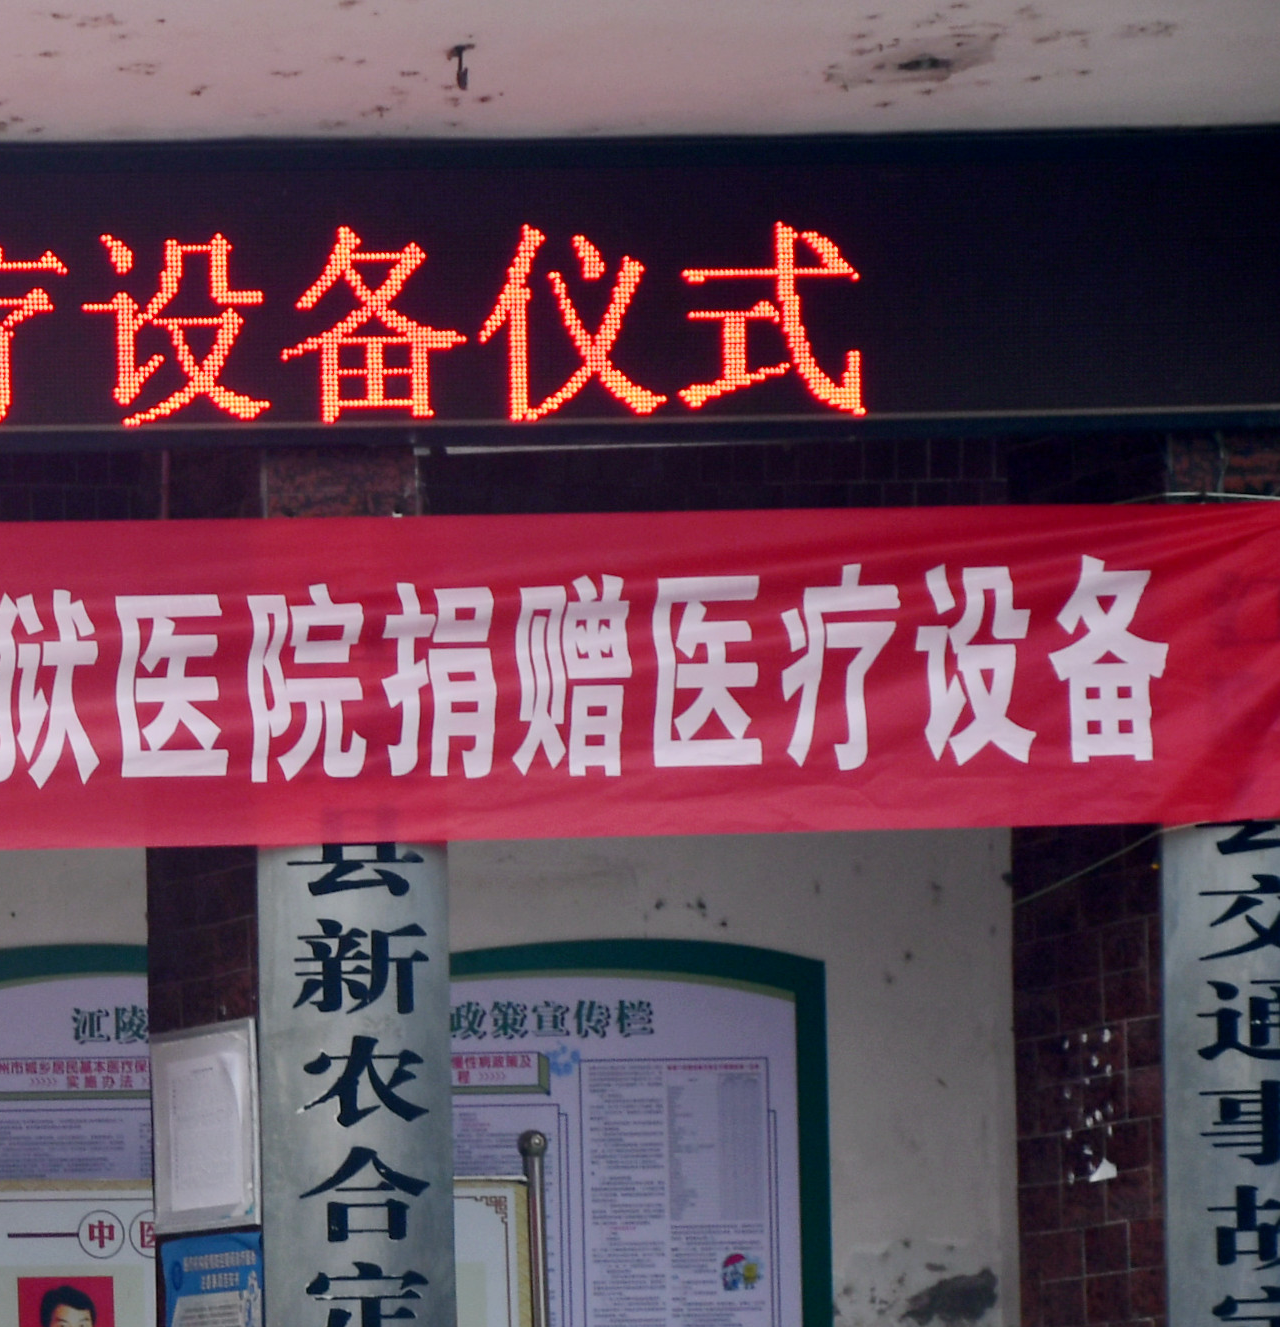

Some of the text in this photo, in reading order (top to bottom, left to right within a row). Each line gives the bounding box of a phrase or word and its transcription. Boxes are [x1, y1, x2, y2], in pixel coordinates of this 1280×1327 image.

[72, 1005, 149, 1045] 江陵
[450, 999, 656, 1040] 政策宣传栏
